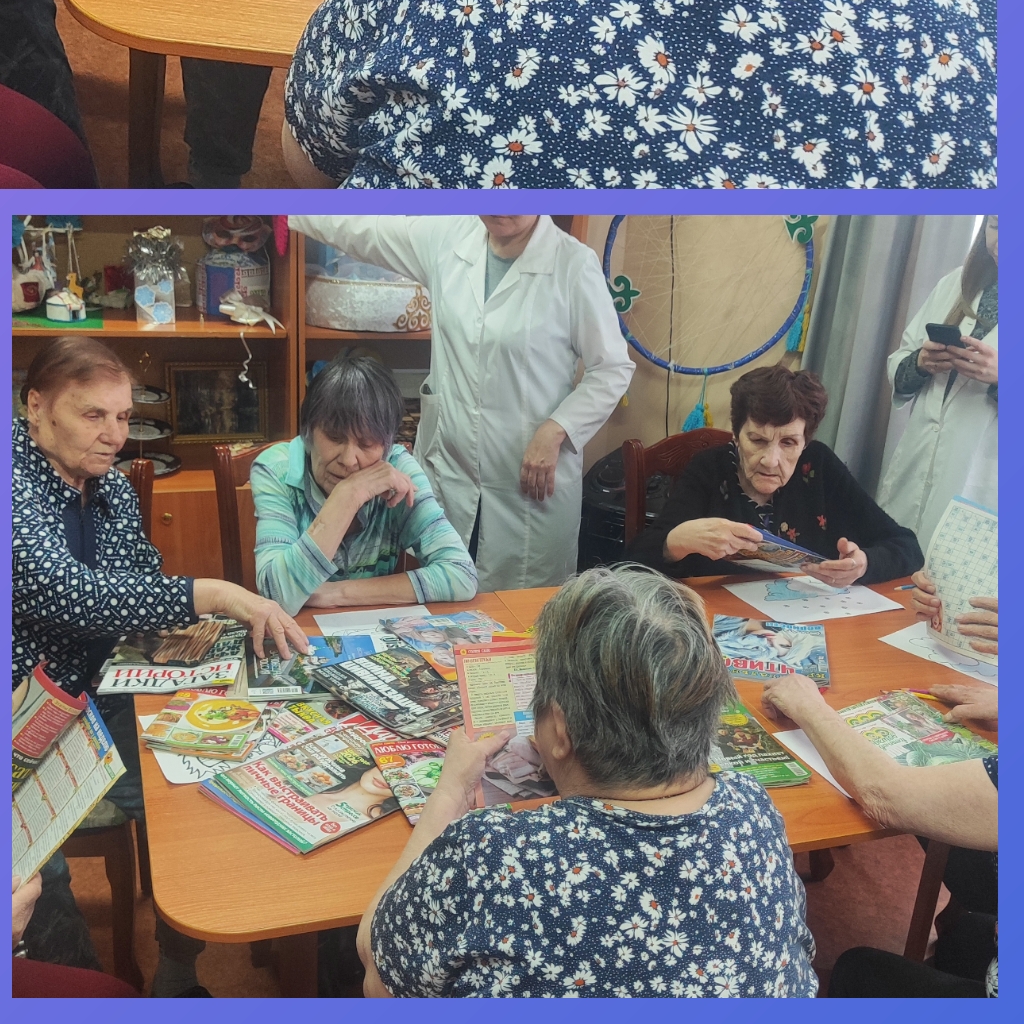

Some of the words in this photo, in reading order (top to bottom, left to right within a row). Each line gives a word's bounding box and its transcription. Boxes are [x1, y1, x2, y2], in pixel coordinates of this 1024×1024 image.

[109, 670, 227, 688] ЗАГАДКИ
[374, 743, 411, 754] ЛЮБЛЮ
[243, 765, 279, 795] личные
[277, 794, 320, 826] границы
[251, 761, 272, 777] Как
[270, 776, 328, 821] выстраивать
